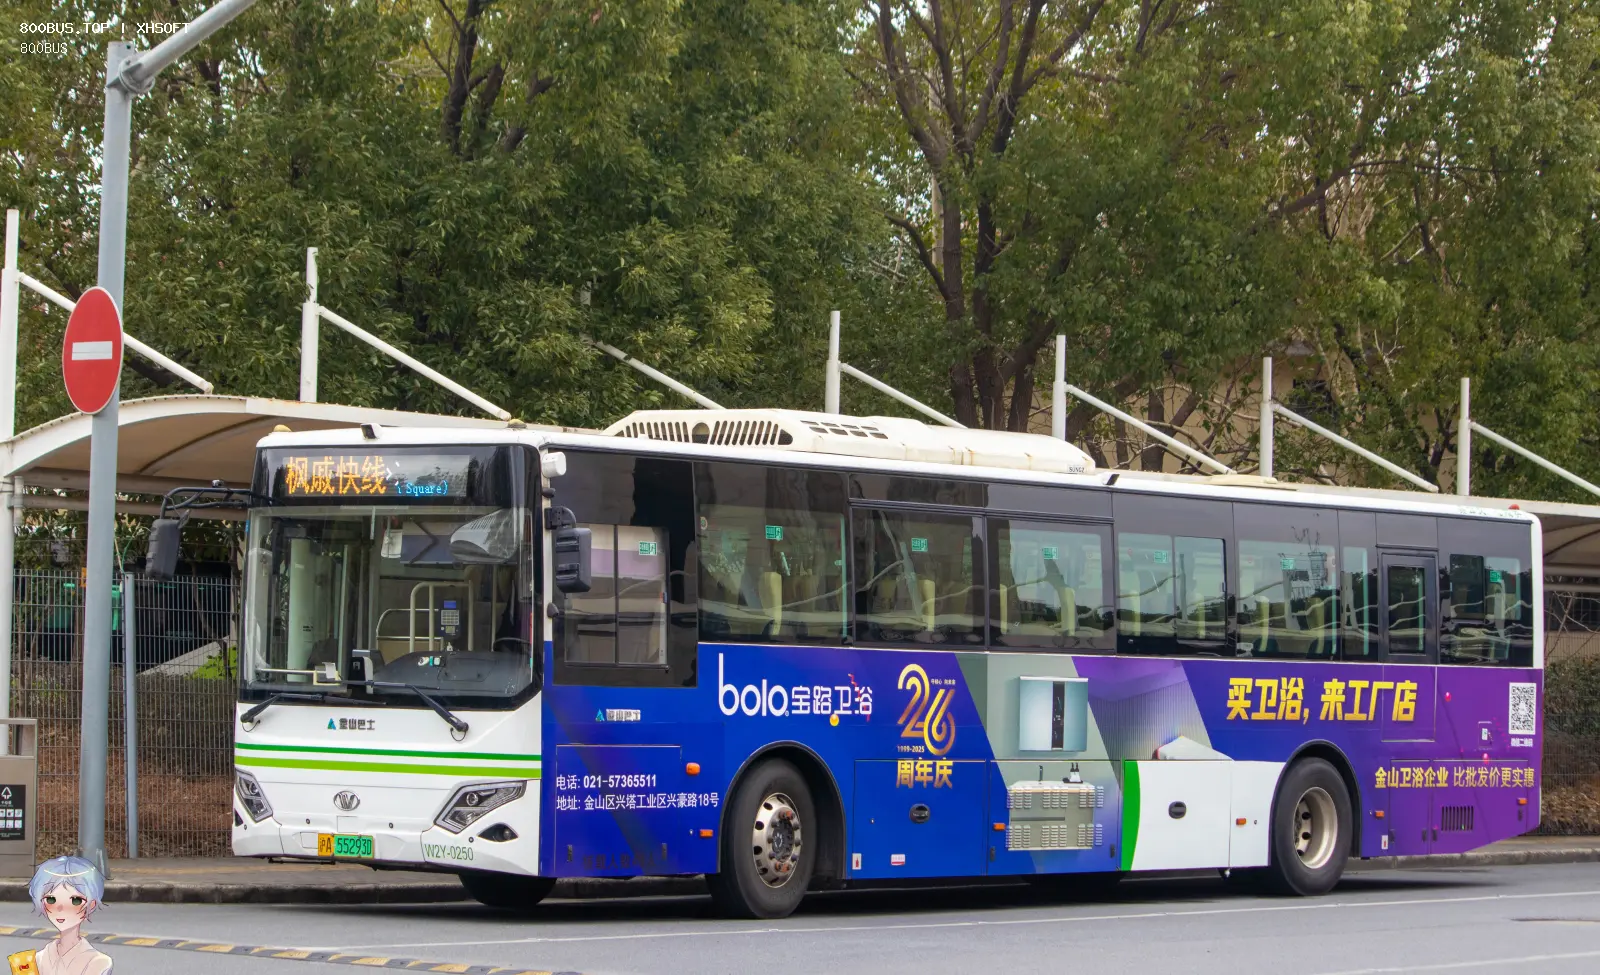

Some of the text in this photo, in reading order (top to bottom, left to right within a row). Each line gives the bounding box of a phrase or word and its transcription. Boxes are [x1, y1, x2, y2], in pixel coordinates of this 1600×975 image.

[284, 455, 387, 495] 枫戚快线
[718, 652, 789, 717] bolo
[791, 685, 873, 715] 宝路卫浴
[897, 663, 956, 756] 26
[583, 774, 657, 788] 021-57365511
[896, 757, 954, 789] 周年庆
[1374, 766, 1536, 789] 金山卫浴企业 比批发价更实惠
[337, 837, 372, 856] 55293D
[424, 843, 474, 861] W2Y-0250
